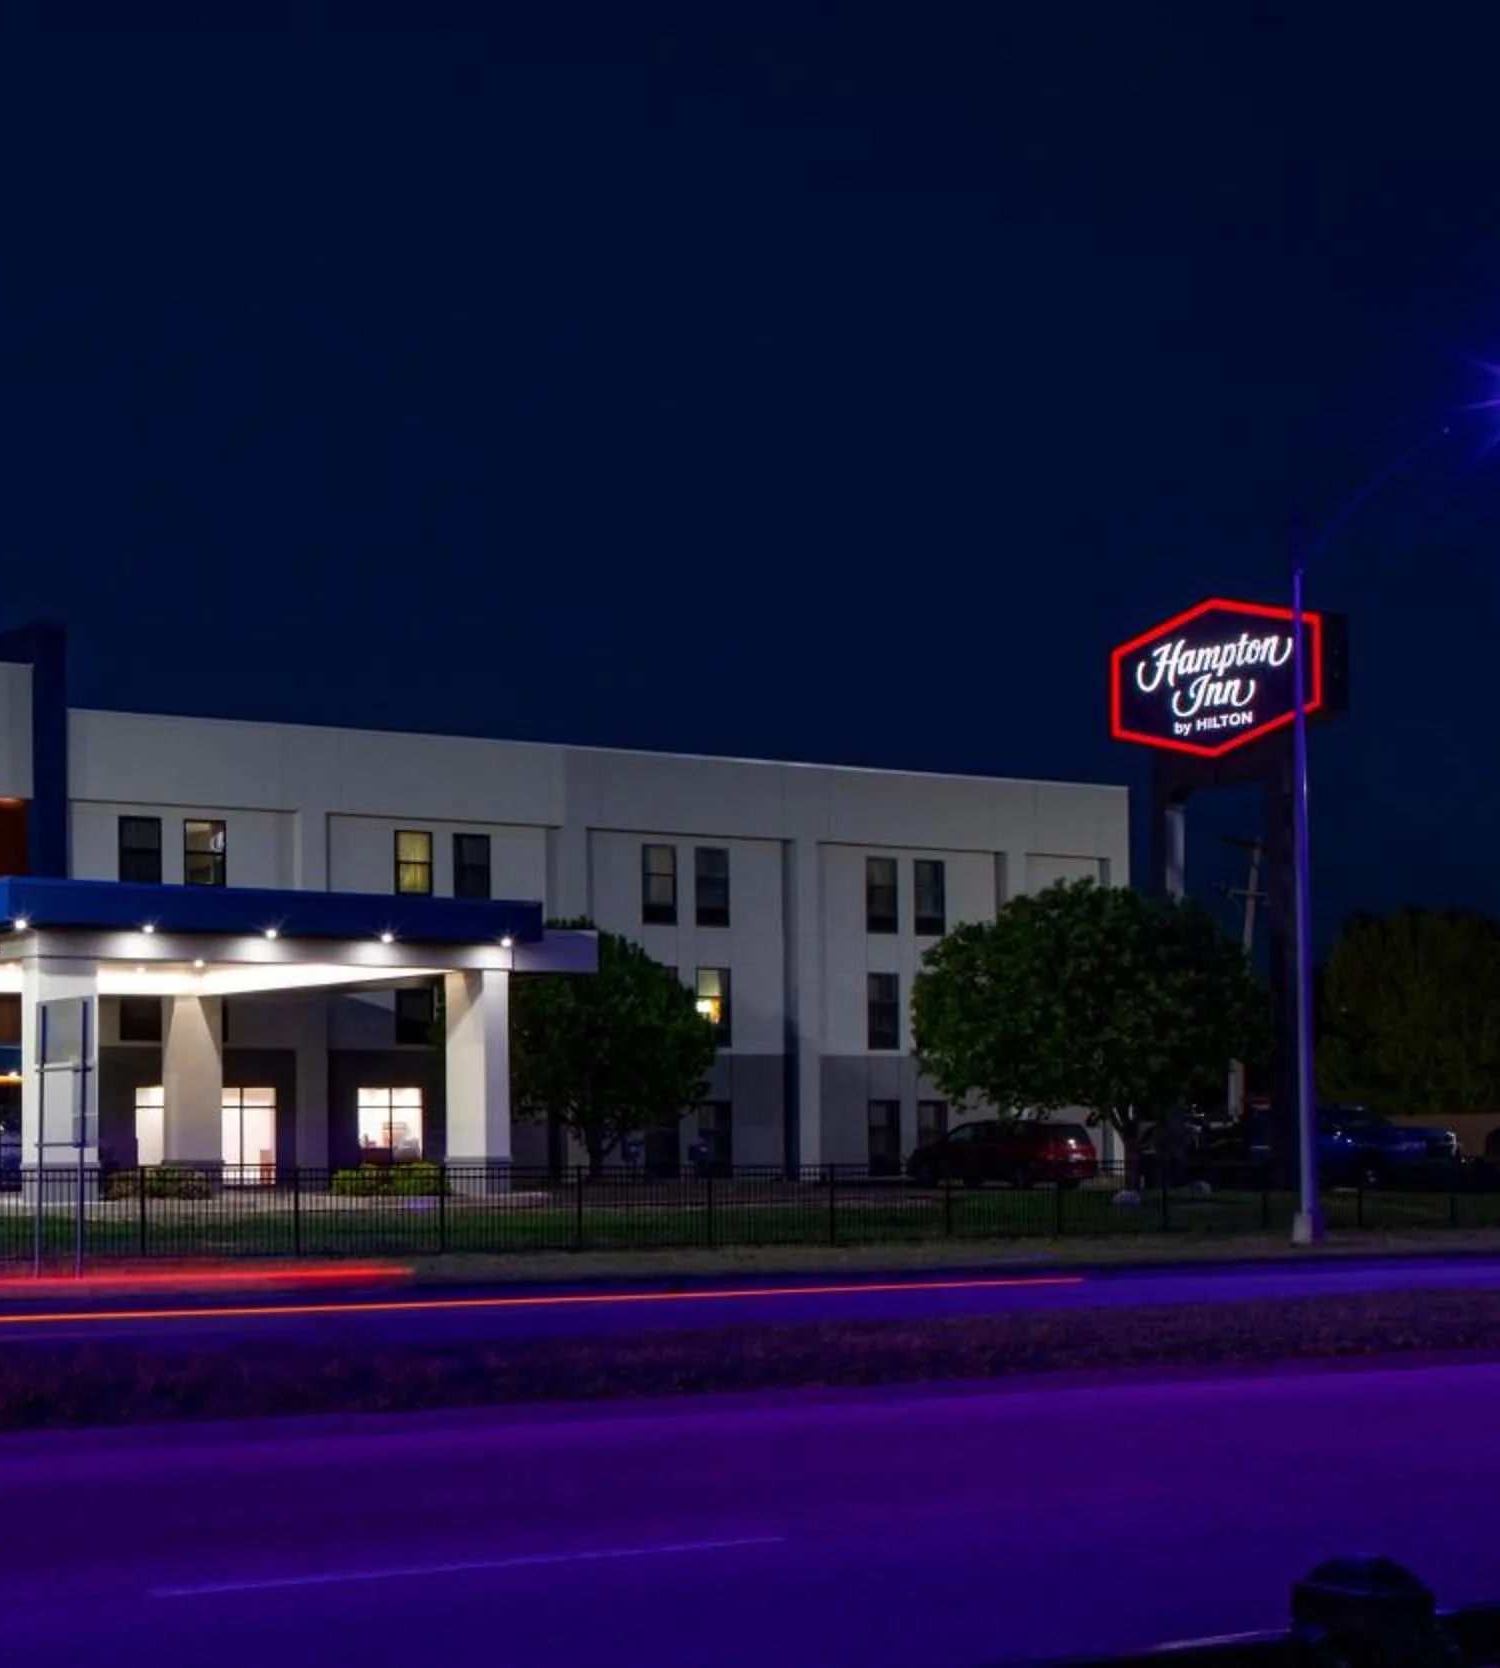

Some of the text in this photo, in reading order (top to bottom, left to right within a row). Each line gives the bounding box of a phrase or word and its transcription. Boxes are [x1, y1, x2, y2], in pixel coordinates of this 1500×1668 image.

[1136, 632, 1293, 692] Hampton
[1172, 673, 1256, 717] Inn
[1173, 711, 1254, 737] by HILTON
